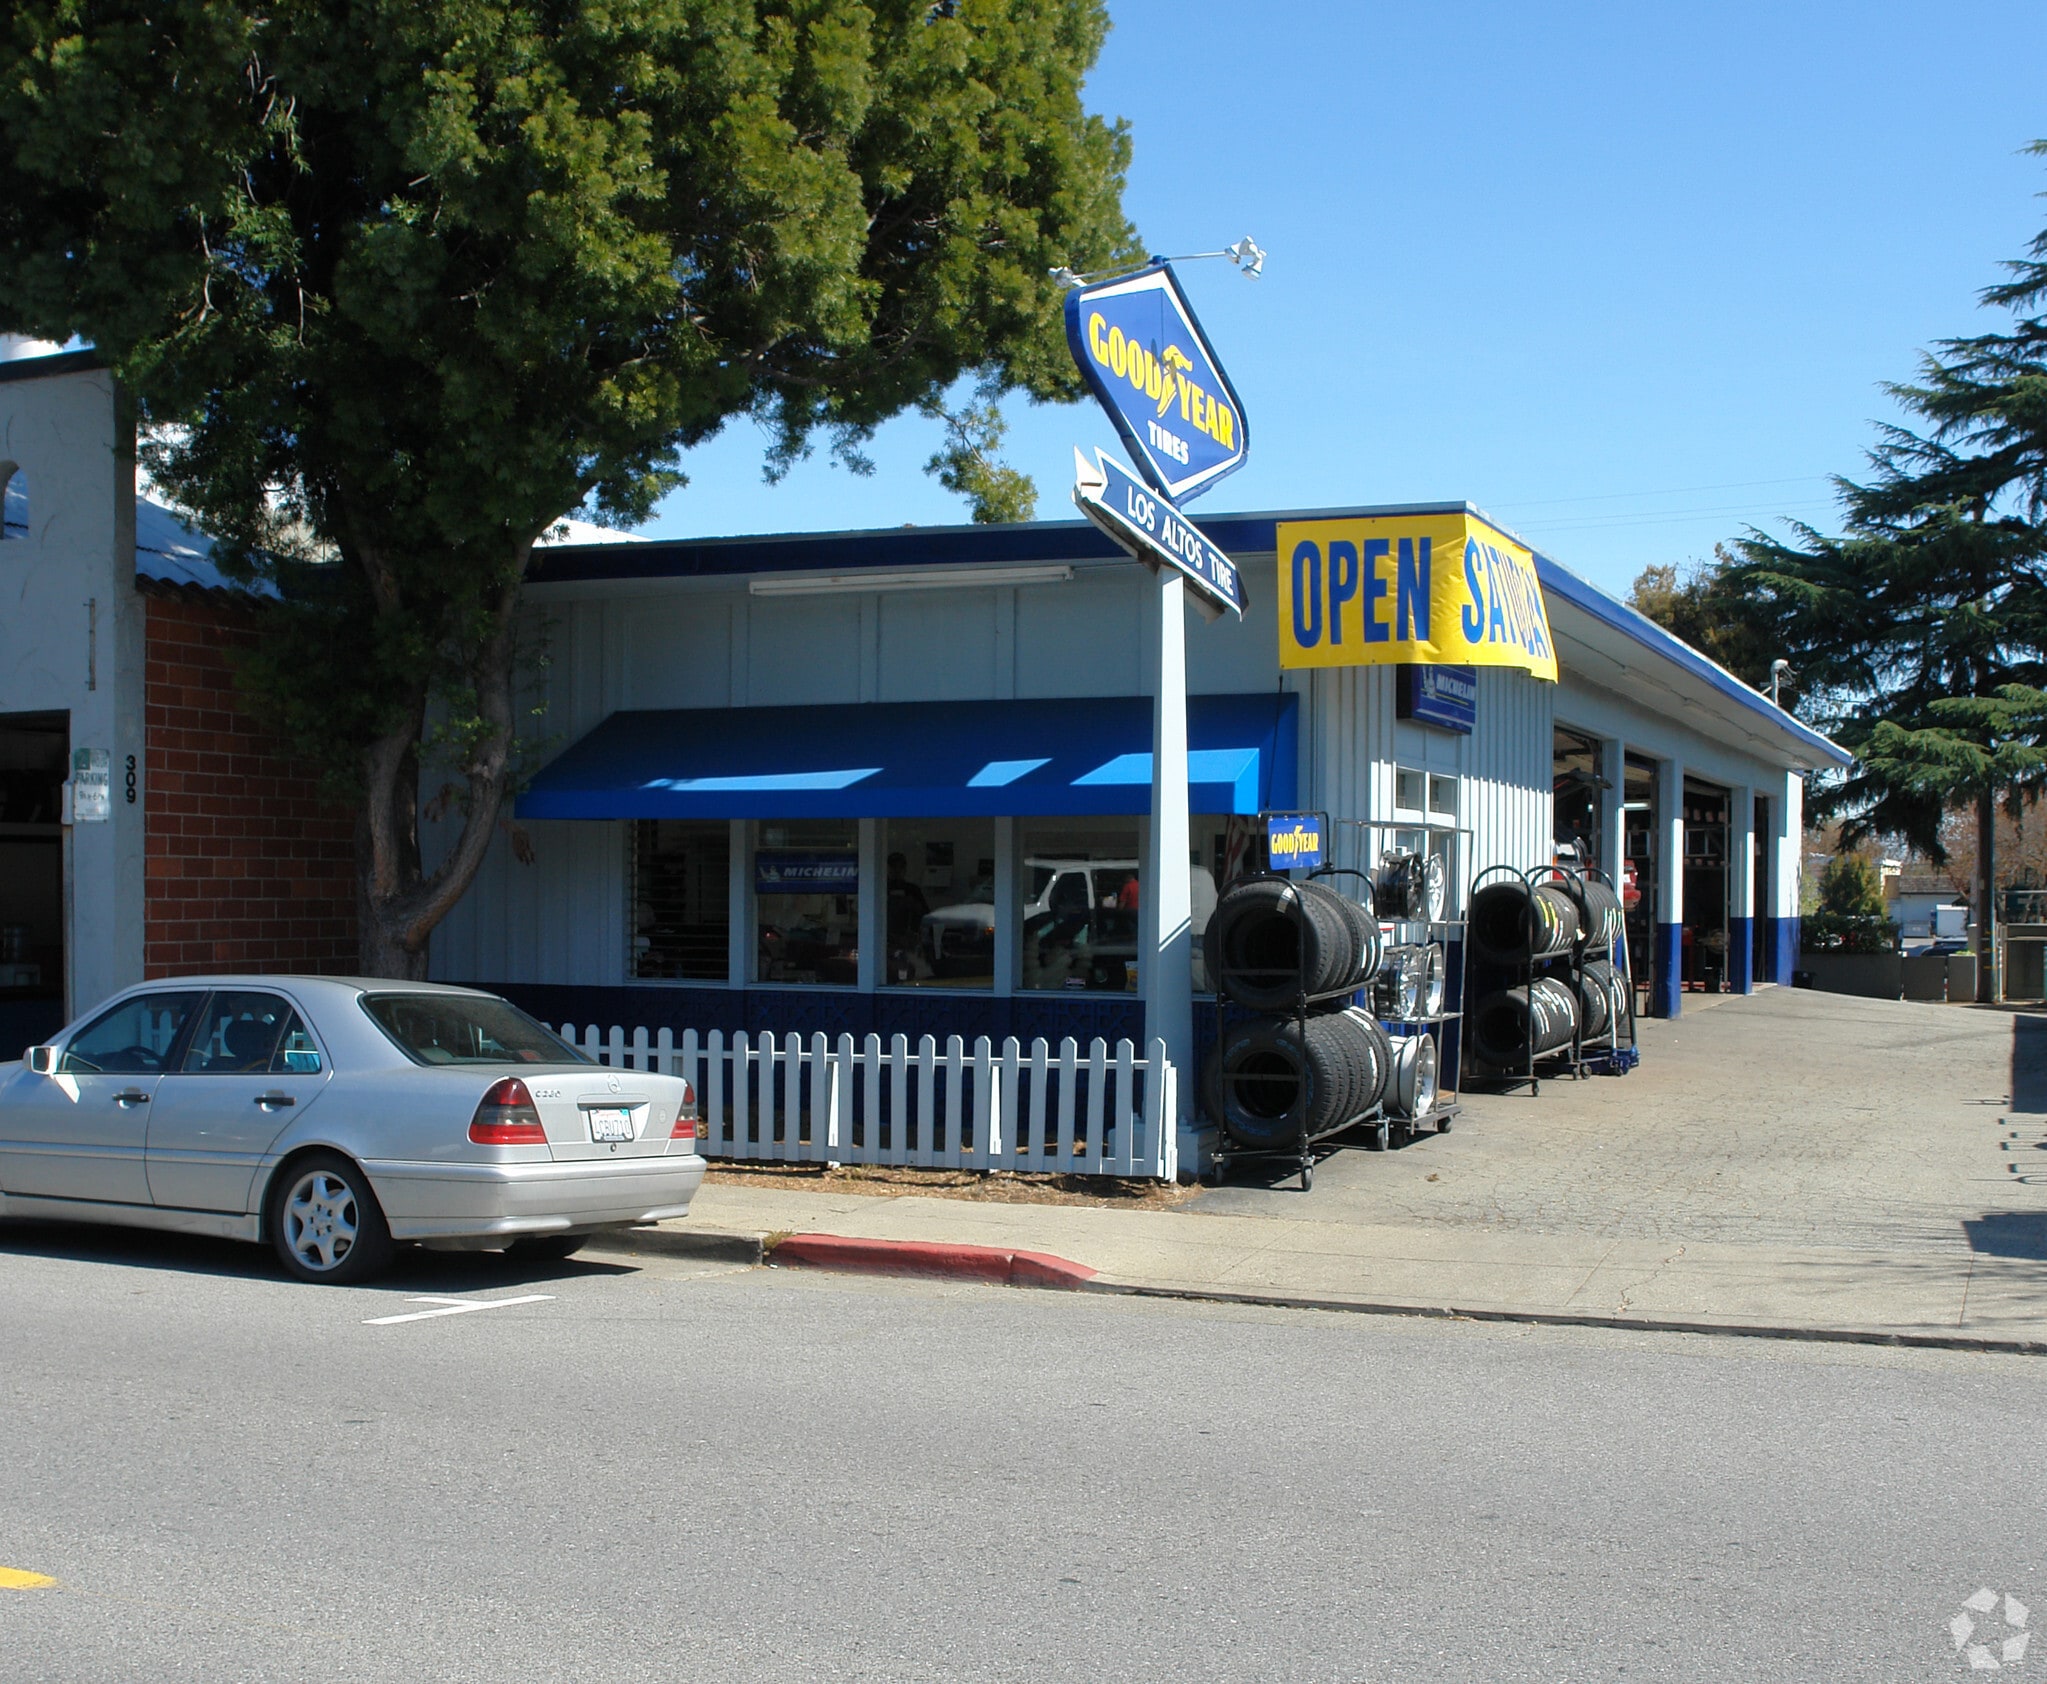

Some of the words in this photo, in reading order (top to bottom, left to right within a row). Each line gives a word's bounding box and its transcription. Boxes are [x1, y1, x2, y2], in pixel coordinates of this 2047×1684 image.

[1147, 419, 1189, 465] TIRES
[1127, 485, 1155, 531] LOS
[1161, 515, 1203, 569] ALTOS
[1208, 551, 1234, 596] TIRE
[1291, 536, 1432, 649] OPEN
[126, 754, 136, 804] 309
[783, 866, 859, 877] MICHELIN
